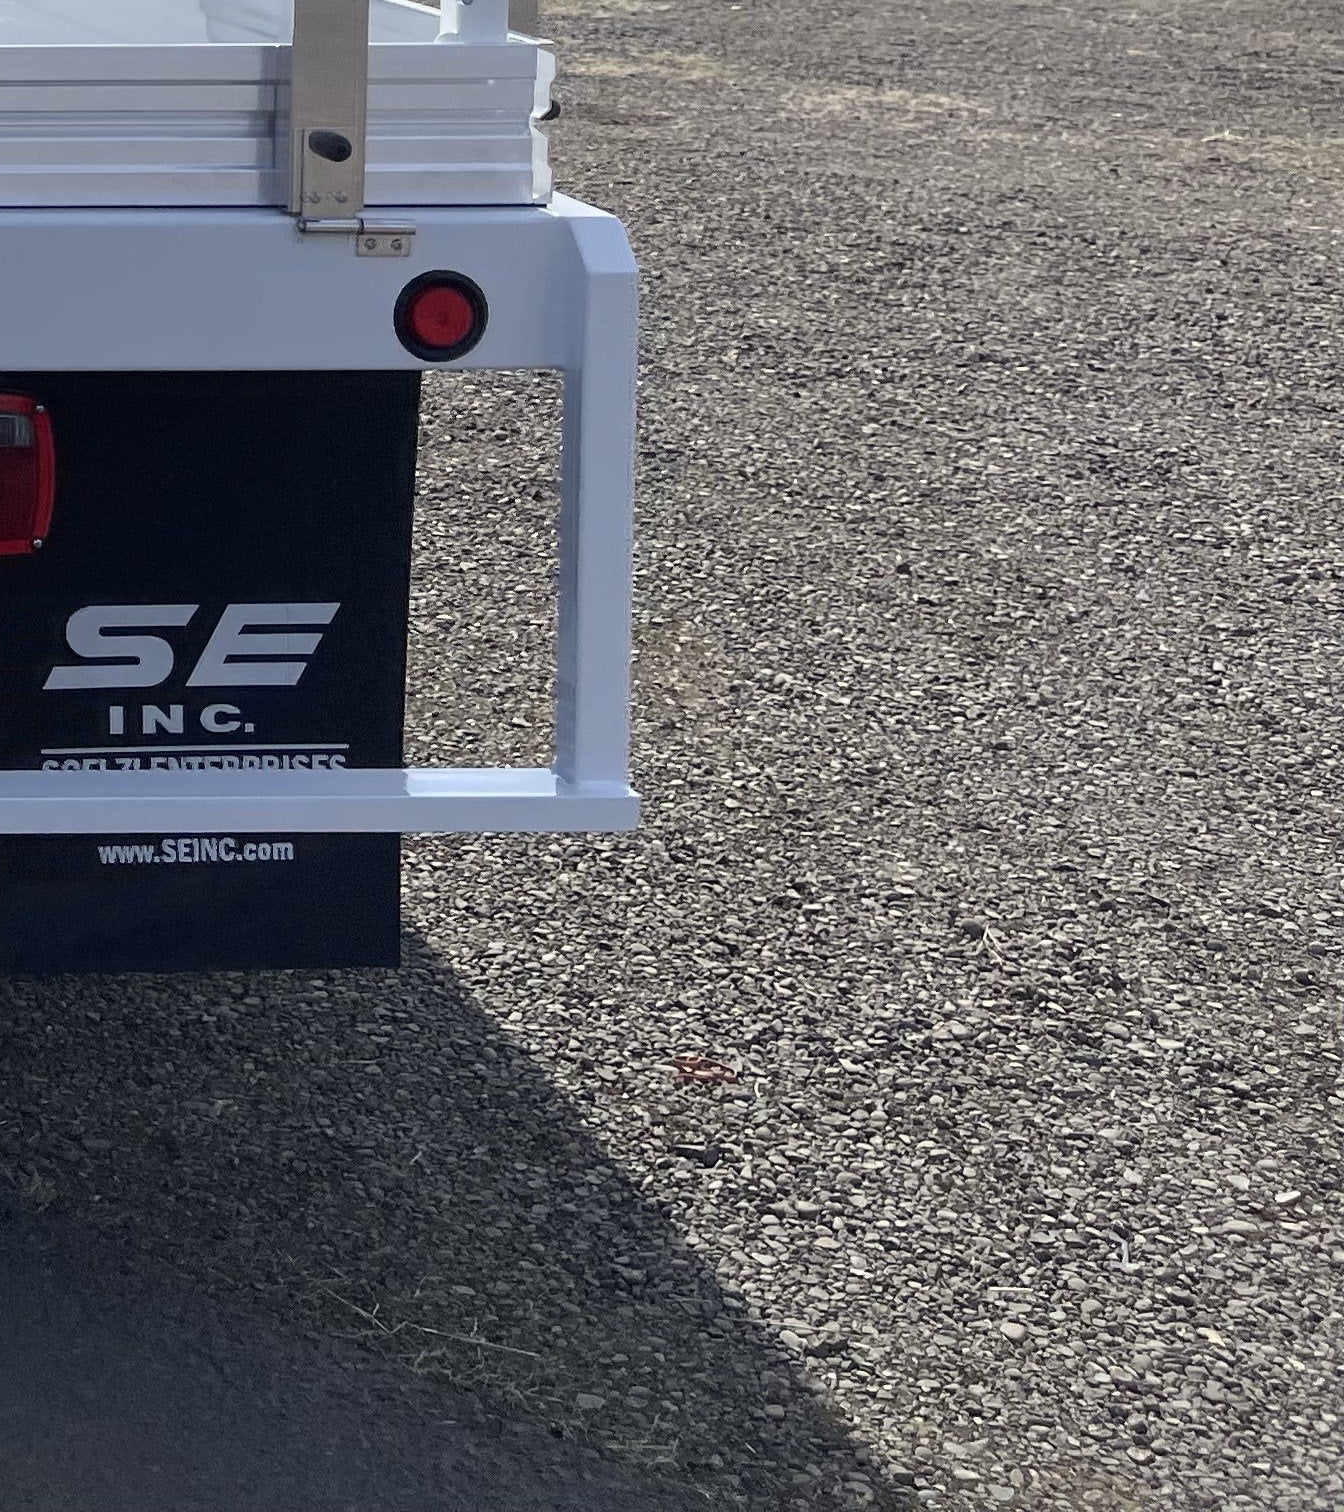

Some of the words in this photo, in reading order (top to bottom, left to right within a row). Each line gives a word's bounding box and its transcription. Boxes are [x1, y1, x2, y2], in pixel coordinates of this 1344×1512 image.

[43, 602, 341, 690] SE
[108, 703, 255, 735] INC.
[98, 837, 294, 864] www.SEINC.com
